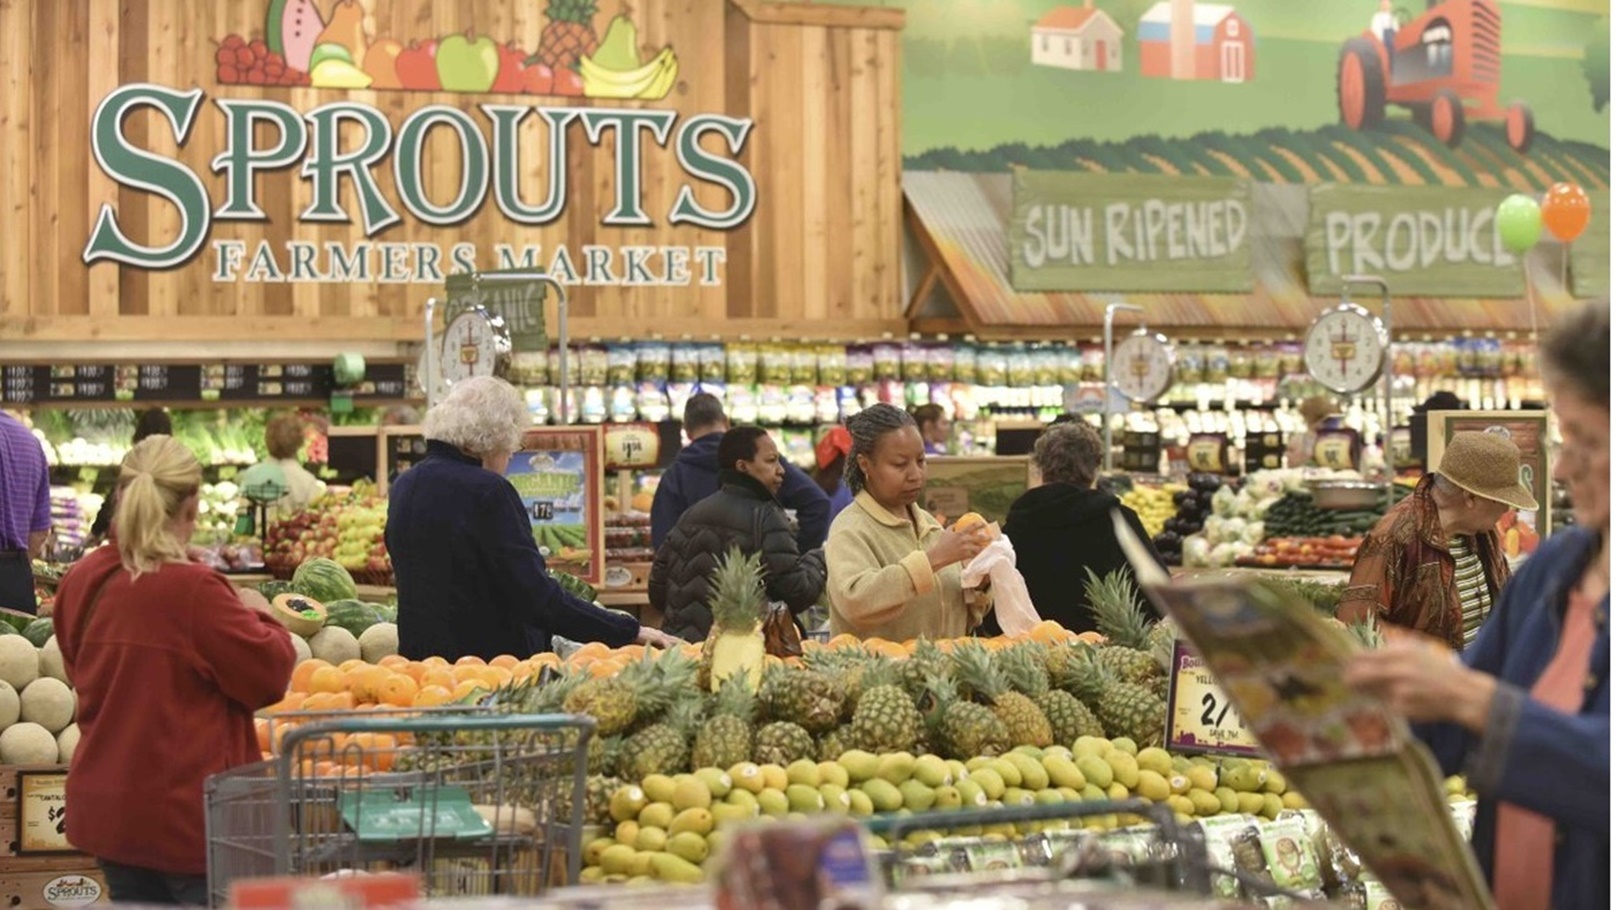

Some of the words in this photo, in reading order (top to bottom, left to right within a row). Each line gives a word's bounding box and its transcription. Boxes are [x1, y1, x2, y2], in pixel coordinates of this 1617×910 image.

[83, 83, 756, 268] SPROUTS
[1024, 204, 1094, 268] SUN
[1104, 198, 1247, 266] RIPENED
[212, 239, 478, 283] FARMERS
[496, 243, 726, 287] MARKET
[47, 886, 98, 901] SPROUTS
